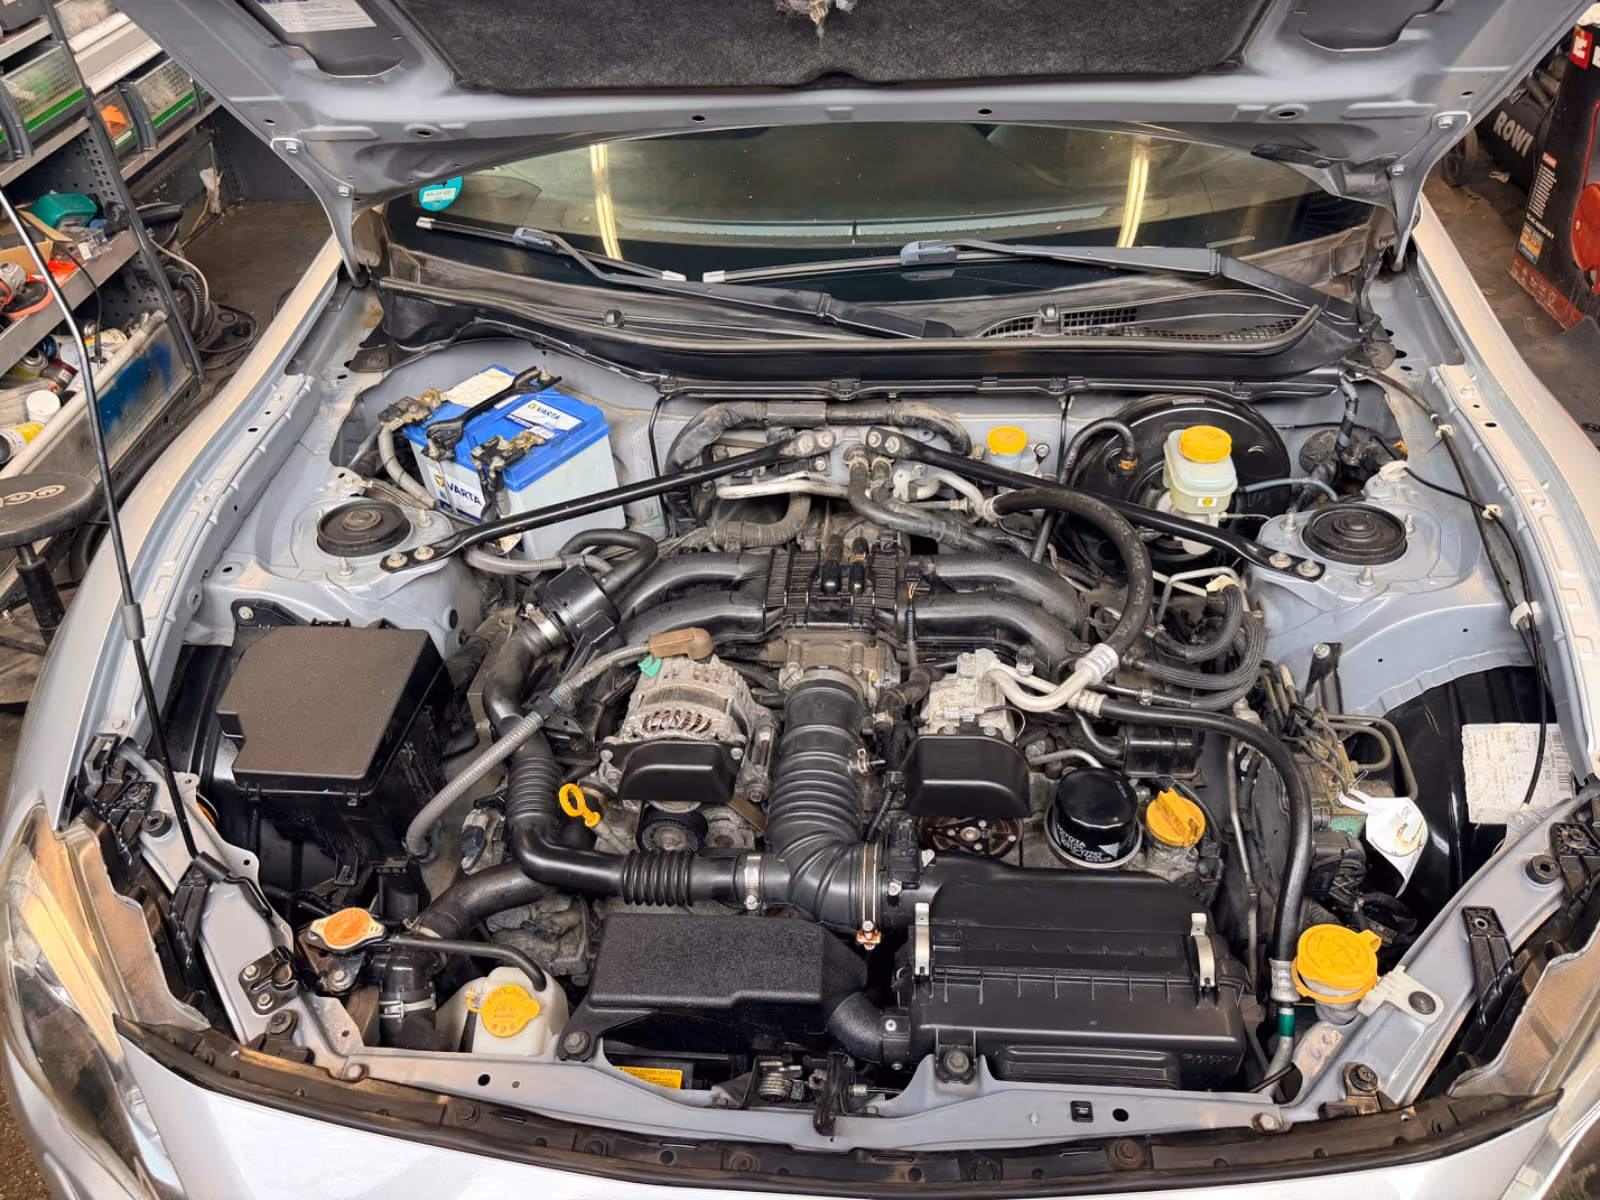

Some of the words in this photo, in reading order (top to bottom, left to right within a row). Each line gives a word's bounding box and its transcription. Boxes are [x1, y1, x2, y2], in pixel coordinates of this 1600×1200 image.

[1493, 111, 1534, 158] ROWI
[537, 407, 560, 420] VARTA
[447, 481, 483, 506] VARTA
